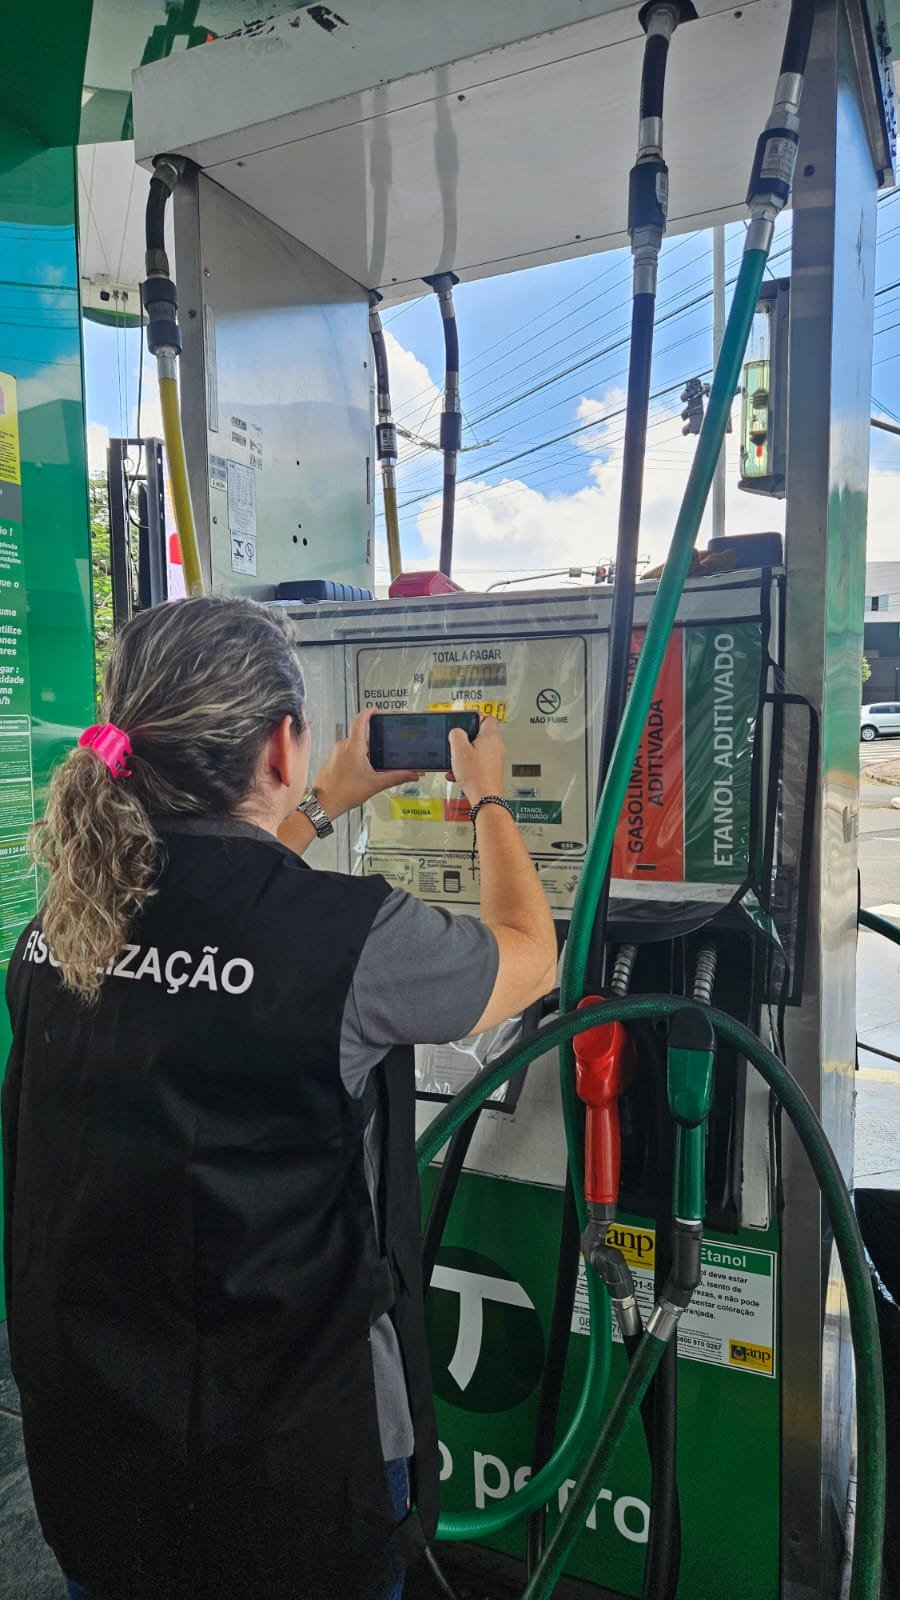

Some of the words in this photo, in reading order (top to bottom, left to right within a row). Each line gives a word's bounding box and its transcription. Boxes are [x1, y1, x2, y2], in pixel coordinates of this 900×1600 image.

[0, 608, 17, 617] ume
[0, 648, 17, 656] ares
[432, 651, 460, 663] TOTAL
[462, 651, 469, 661] A
[470, 649, 501, 661] PAGAR
[0, 666, 15, 675] gar
[413, 673, 425, 683] R$
[364, 688, 409, 699] DESLIGUE
[451, 690, 483, 700] LITROS
[376, 700, 408, 710] MOTOR
[713, 633, 735, 769] ADITIVADO
[529, 715, 546, 725] NÃO
[547, 716, 569, 724] FUME
[647, 699, 664, 807] ADITIVADA
[627, 755, 644, 854] GASOLINA
[402, 808, 431, 816] GASOLINA
[713, 774, 734, 867] ETANOL
[419, 857, 426, 869] 2
[22, 929, 255, 995] FISIZAÇÃO
[606, 1229, 654, 1258] anp
[700, 1247, 747, 1268] Etanol
[708, 1271, 727, 1280] deve
[728, 1275, 748, 1284] estar
[707, 1282, 731, 1291] isento
[693, 1289, 716, 1299] rezas,
[724, 1294, 739, 1303] não
[741, 1299, 760, 1308] pode
[683, 1308, 717, 1319] aranjada.
[692, 1299, 716, 1308] sentar
[717, 1304, 755, 1317] coloração
[746, 1348, 771, 1363] anp
